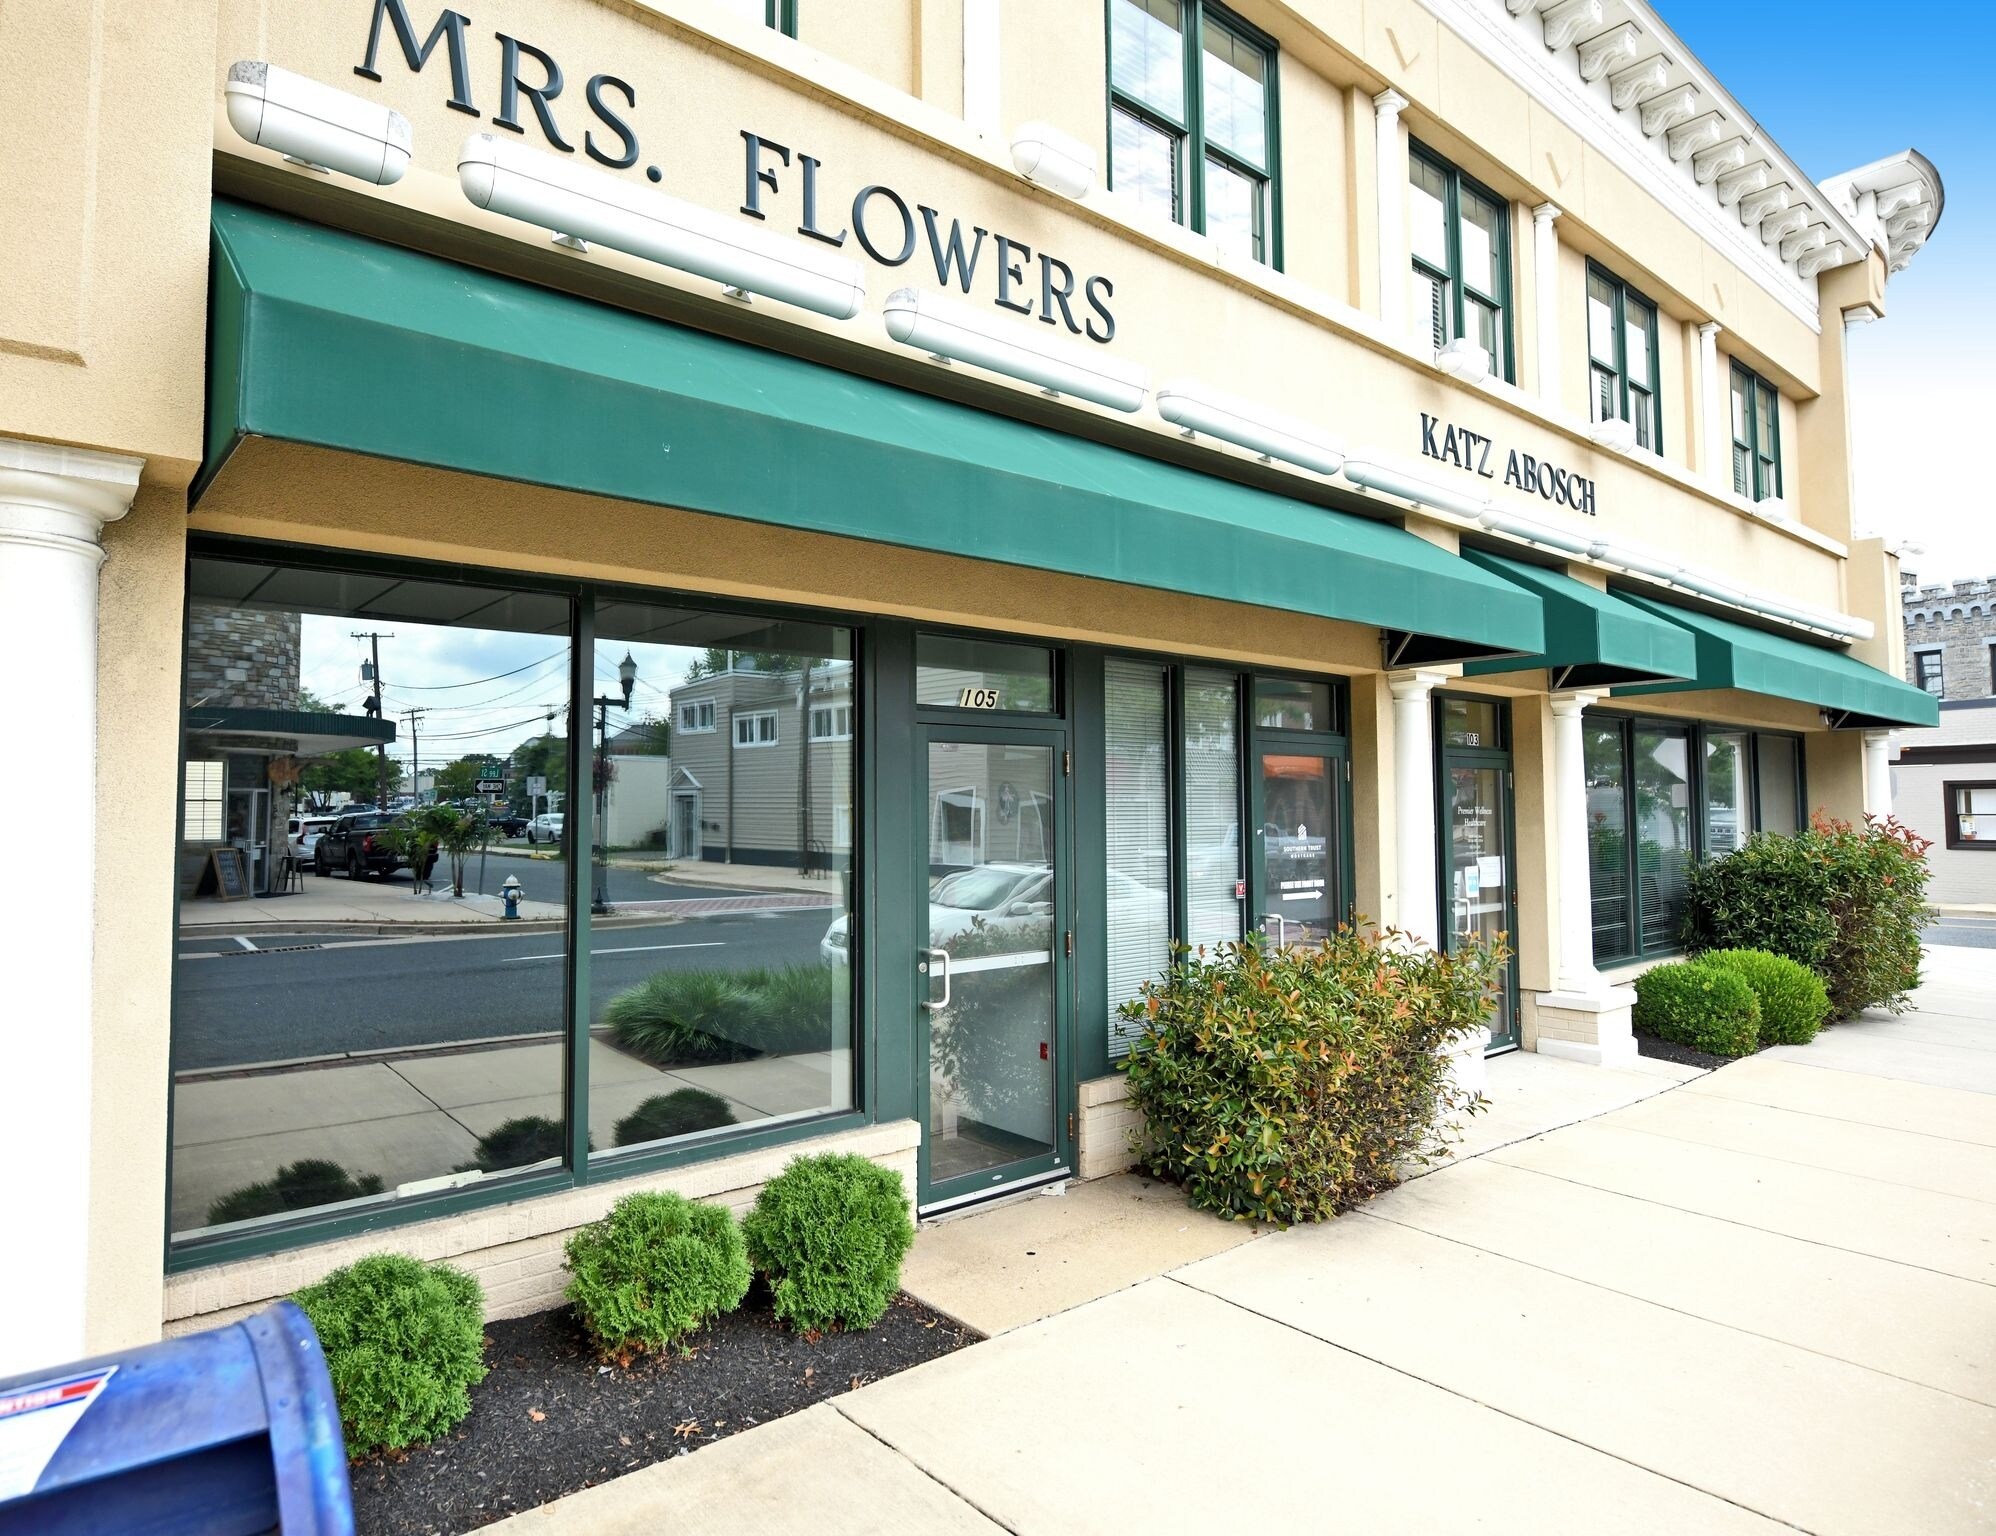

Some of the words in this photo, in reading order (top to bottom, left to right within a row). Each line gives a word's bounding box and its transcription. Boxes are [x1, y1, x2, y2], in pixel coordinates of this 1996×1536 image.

[354, 0, 662, 183] MRS.
[740, 129, 1115, 343] FLOWERS
[1420, 412, 1494, 479] KATZ
[1503, 449, 1596, 516] ABOSCH
[964, 689, 997, 708] 105
[1466, 732, 1479, 746] 103
